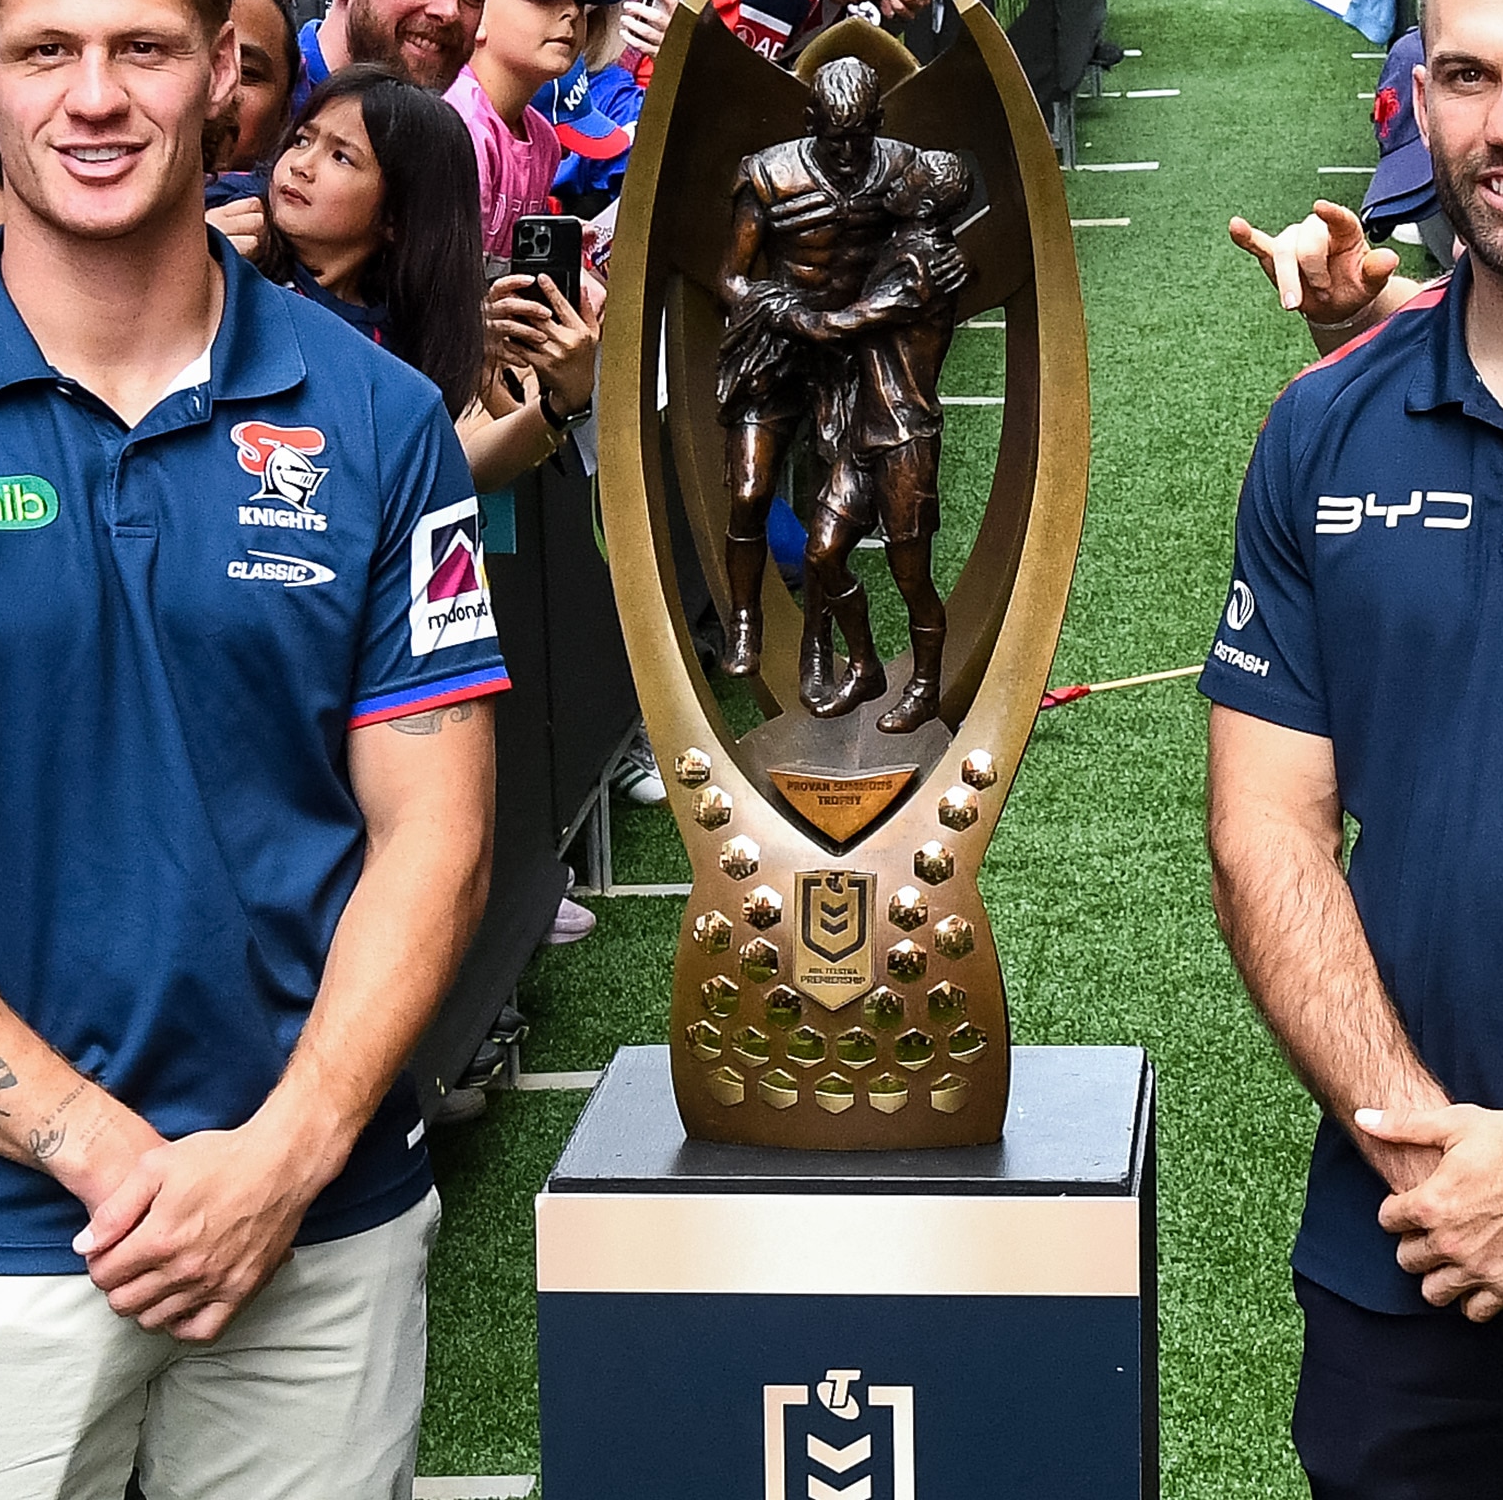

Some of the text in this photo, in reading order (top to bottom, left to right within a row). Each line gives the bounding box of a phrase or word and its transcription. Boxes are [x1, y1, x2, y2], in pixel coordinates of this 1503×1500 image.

[236, 506, 328, 532] KNIGHTS
[1314, 491, 1475, 535] BYD
[227, 560, 308, 582] CLASSIC
[786, 780, 831, 792] PROVAN
[817, 794, 863, 806] TROPHY
